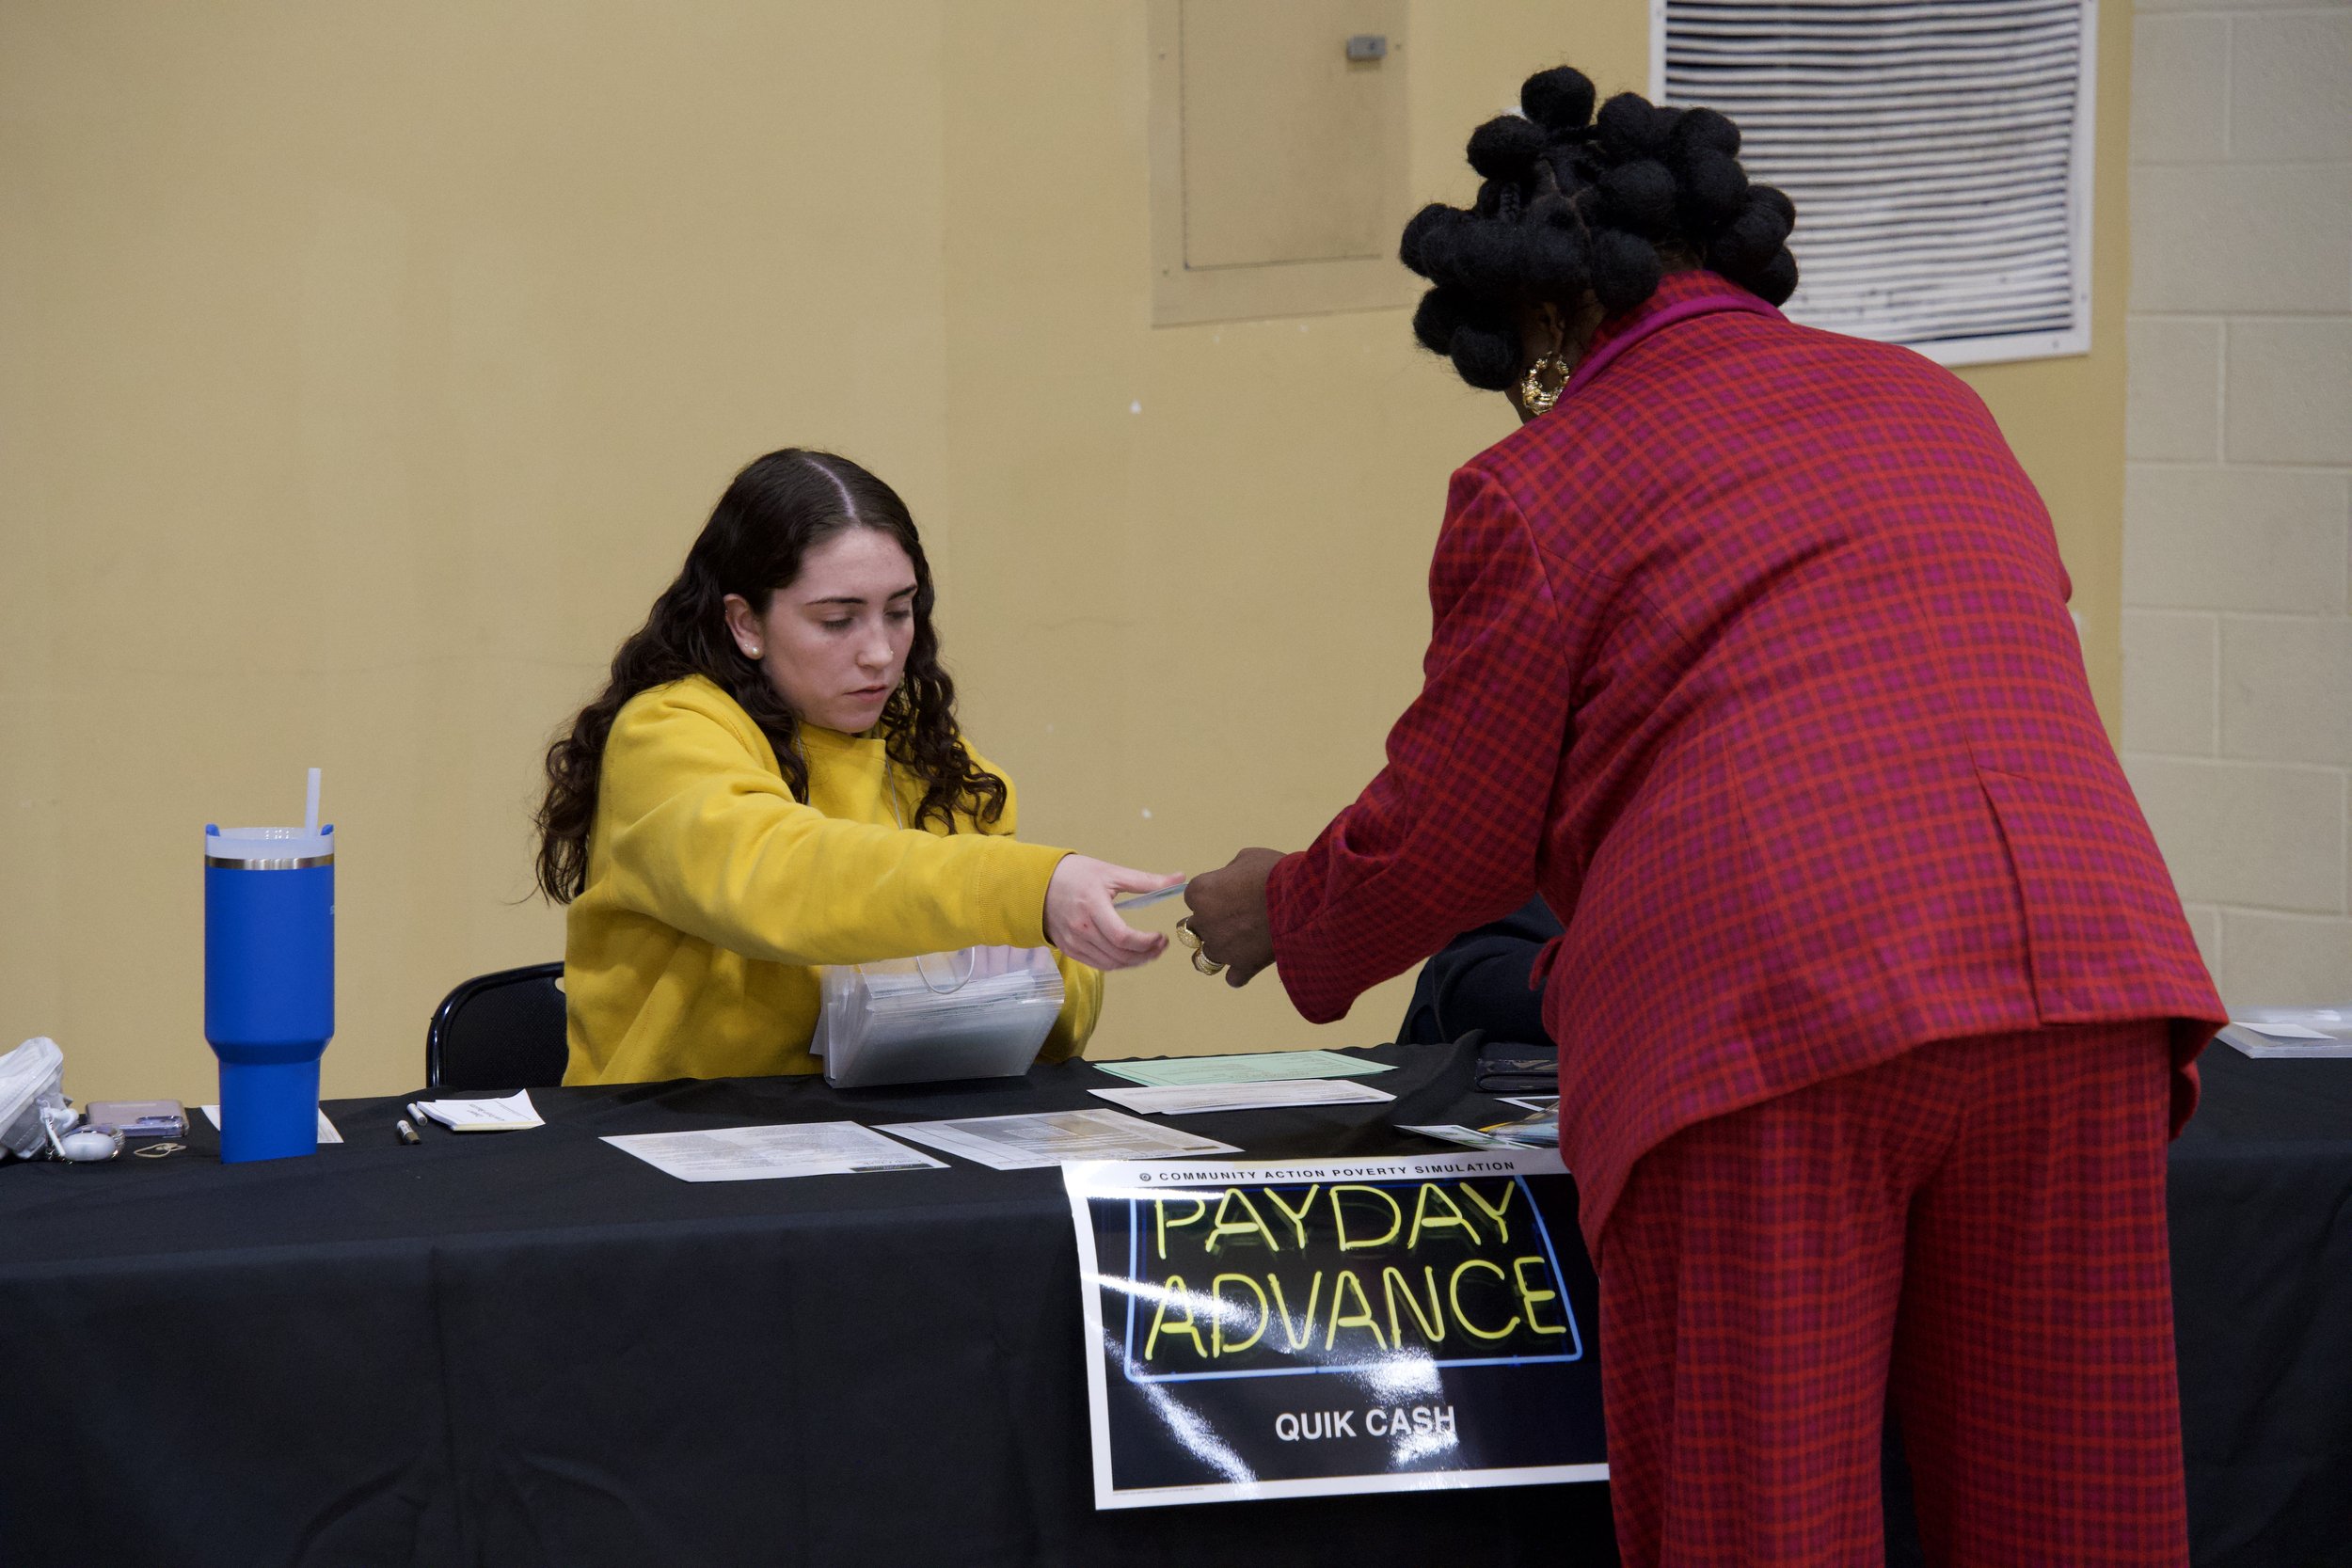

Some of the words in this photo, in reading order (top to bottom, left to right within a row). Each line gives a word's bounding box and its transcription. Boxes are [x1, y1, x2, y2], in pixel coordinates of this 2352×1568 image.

[1159, 1170, 1256, 1180] COMMUNITY
[1264, 1169, 1326, 1179] ACTION
[1332, 1166, 1406, 1177] POVERTY
[1414, 1161, 1515, 1174] SIMULATION
[1155, 1181, 1516, 1259] PAYDAY
[1145, 1257, 1567, 1361] ADVANCE
[1275, 1410, 1358, 1442] QUIK
[1365, 1405, 1456, 1436] CASH
